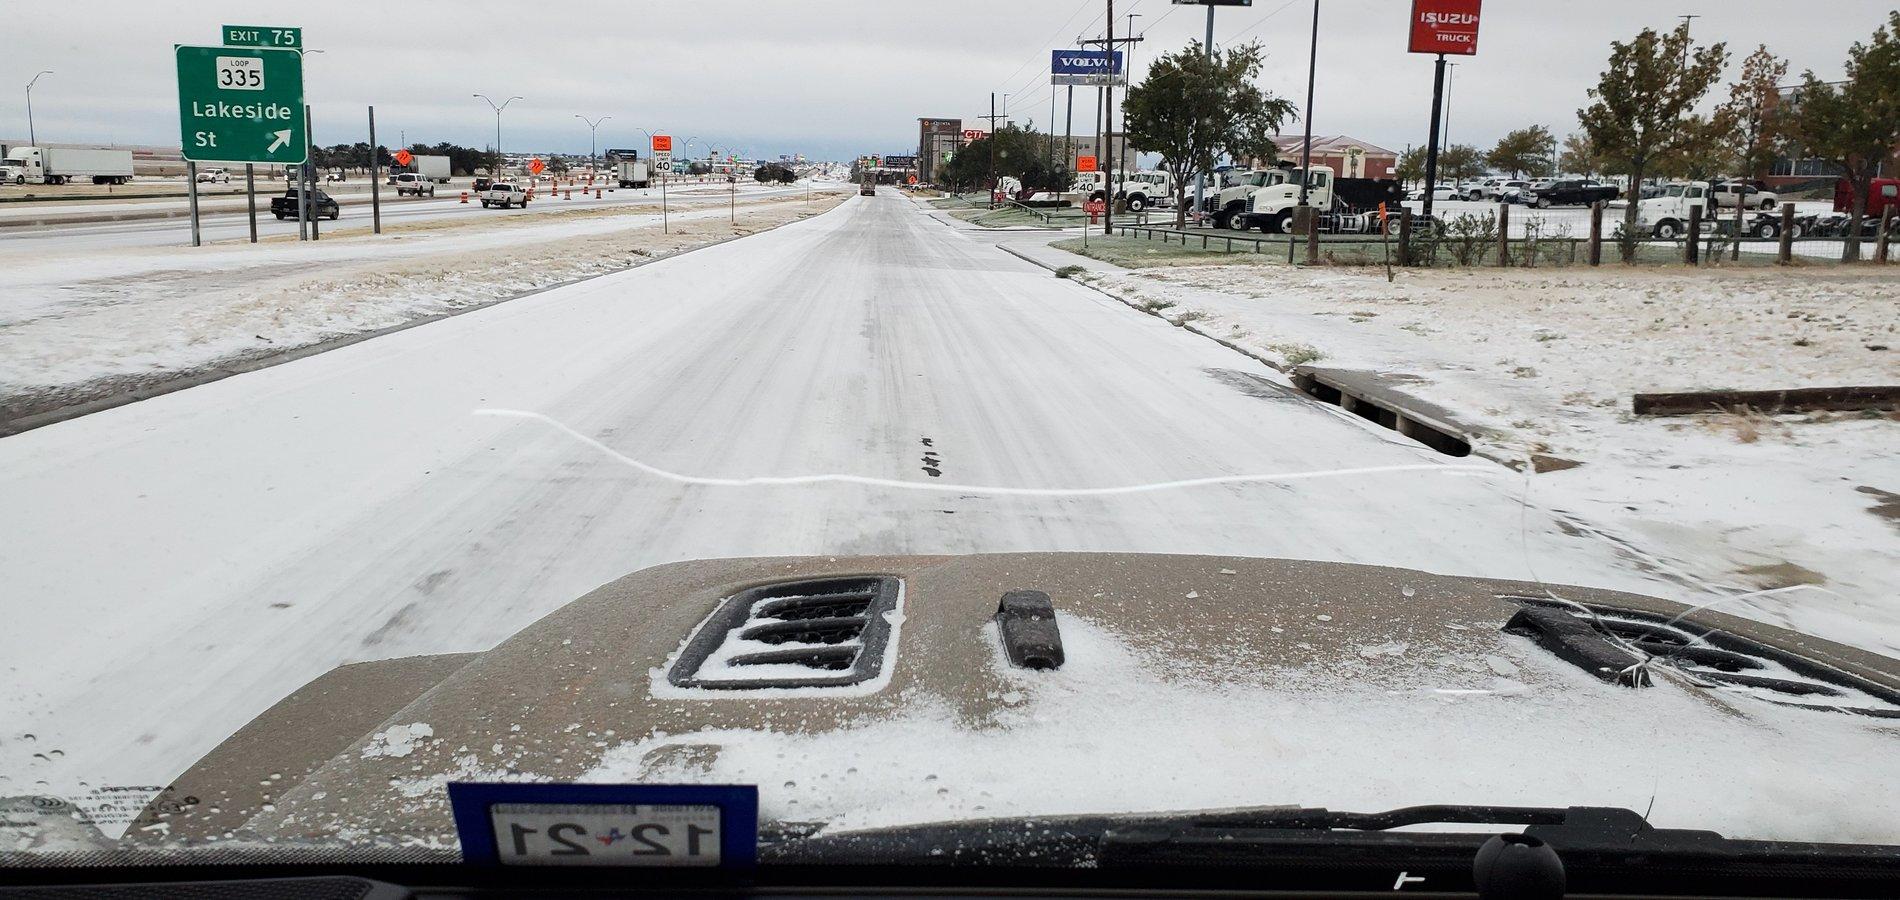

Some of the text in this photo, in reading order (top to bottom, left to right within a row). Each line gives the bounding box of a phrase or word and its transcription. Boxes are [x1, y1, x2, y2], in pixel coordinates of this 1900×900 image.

[1421, 12, 1473, 24] ISUZU
[230, 30, 295, 45] EXIT 75
[1436, 34, 1470, 42] TRUCK
[221, 69, 260, 87] 335
[193, 101, 292, 120] Lakeside
[195, 131, 217, 147] St
[965, 130, 983, 139] CTI
[656, 162, 670, 170] 40
[1079, 183, 1093, 191] 40
